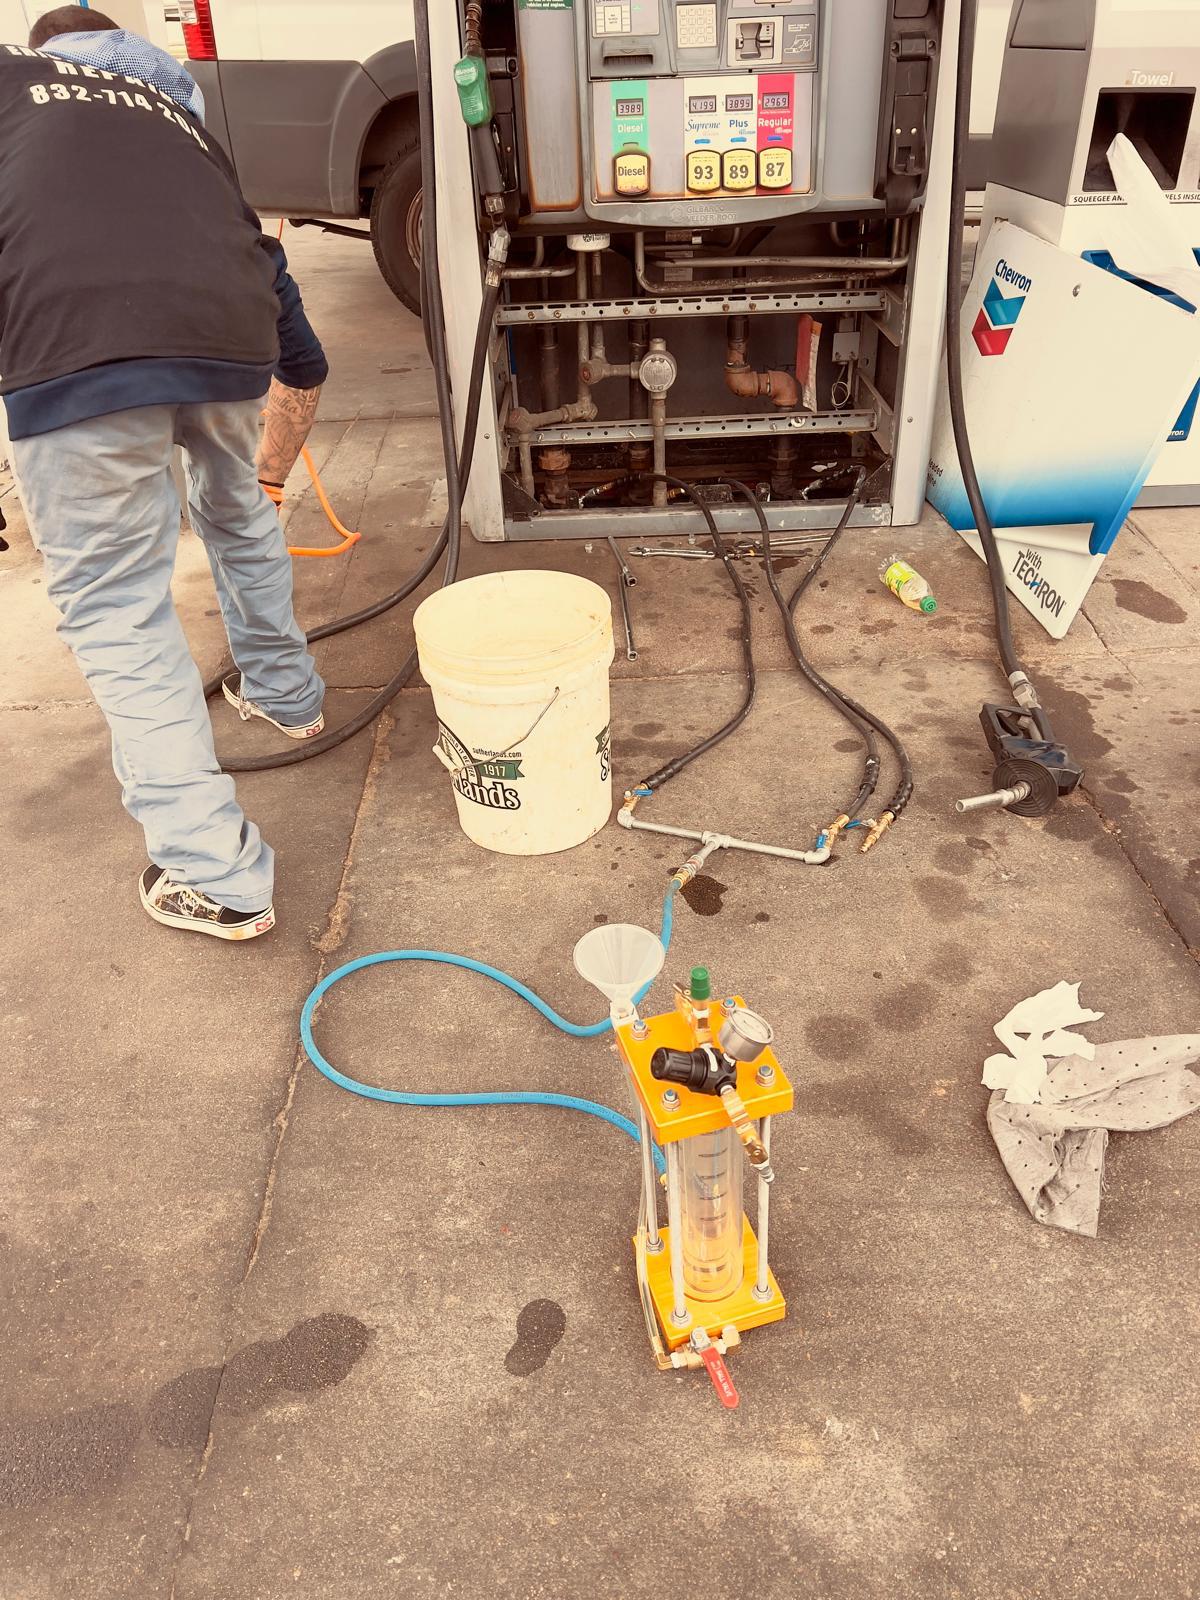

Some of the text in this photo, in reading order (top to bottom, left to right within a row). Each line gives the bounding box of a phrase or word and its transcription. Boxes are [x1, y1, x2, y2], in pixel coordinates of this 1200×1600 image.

[1131, 70, 1174, 86] Towel
[617, 123, 643, 133] Diesel
[685, 119, 721, 132] Supreme
[729, 119, 749, 128] Plus
[758, 117, 792, 127] Regular
[617, 165, 646, 177] Diesel
[694, 165, 714, 180] 93
[729, 164, 749, 179] 89
[766, 162, 785, 177] 87
[1073, 195, 1110, 203] SQUEEGEE
[995, 258, 1032, 293] Chevron
[1025, 548, 1042, 570] with
[1012, 550, 1066, 618] TECHRON
[483, 764, 506, 777] 1917
